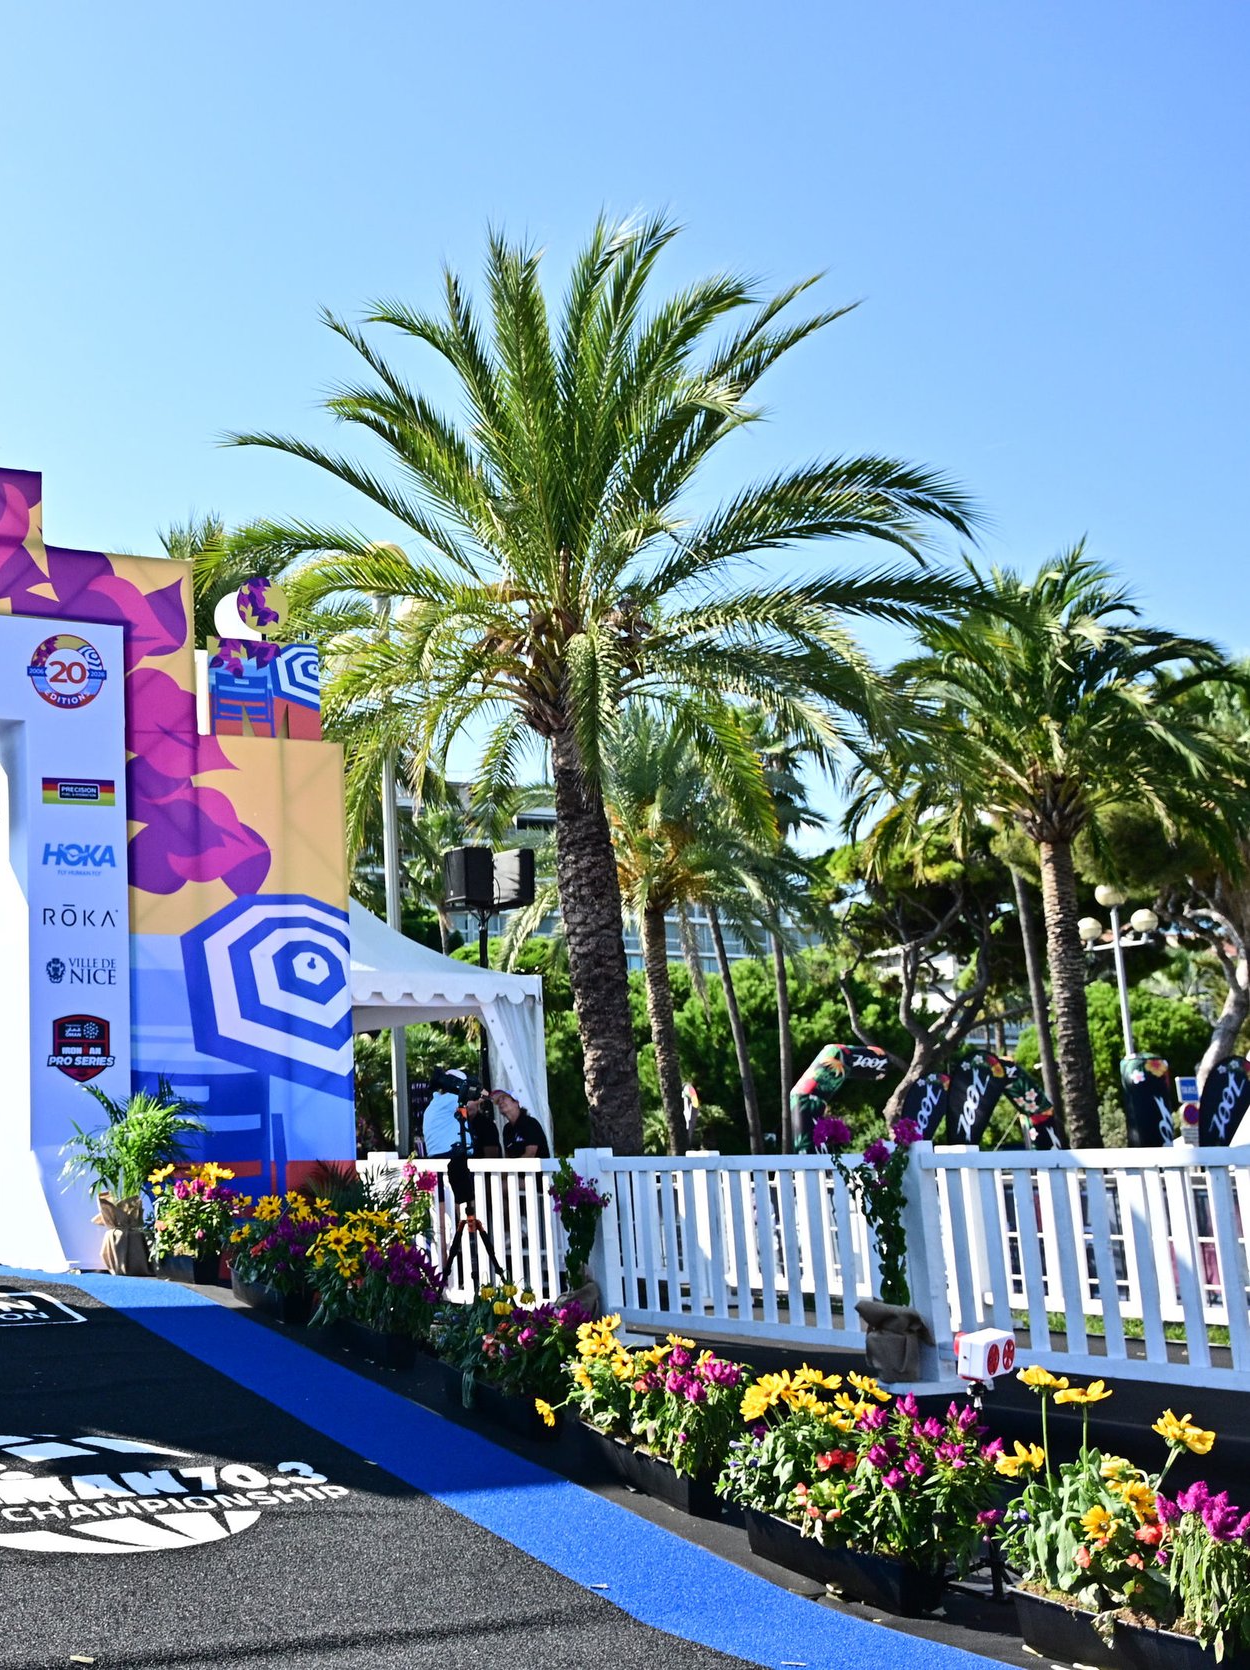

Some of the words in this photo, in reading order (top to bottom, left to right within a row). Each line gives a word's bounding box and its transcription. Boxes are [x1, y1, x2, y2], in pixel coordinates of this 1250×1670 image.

[49, 661, 87, 684] 20
[42, 843, 117, 867] HOKA
[69, 958, 99, 968] VILLE
[102, 959, 116, 968] DE
[70, 968, 117, 985] NICE
[49, 1056, 73, 1066] PRO
[74, 1056, 114, 1066] SERIES
[1, 1485, 349, 1521] CHAMPIONSHIP
